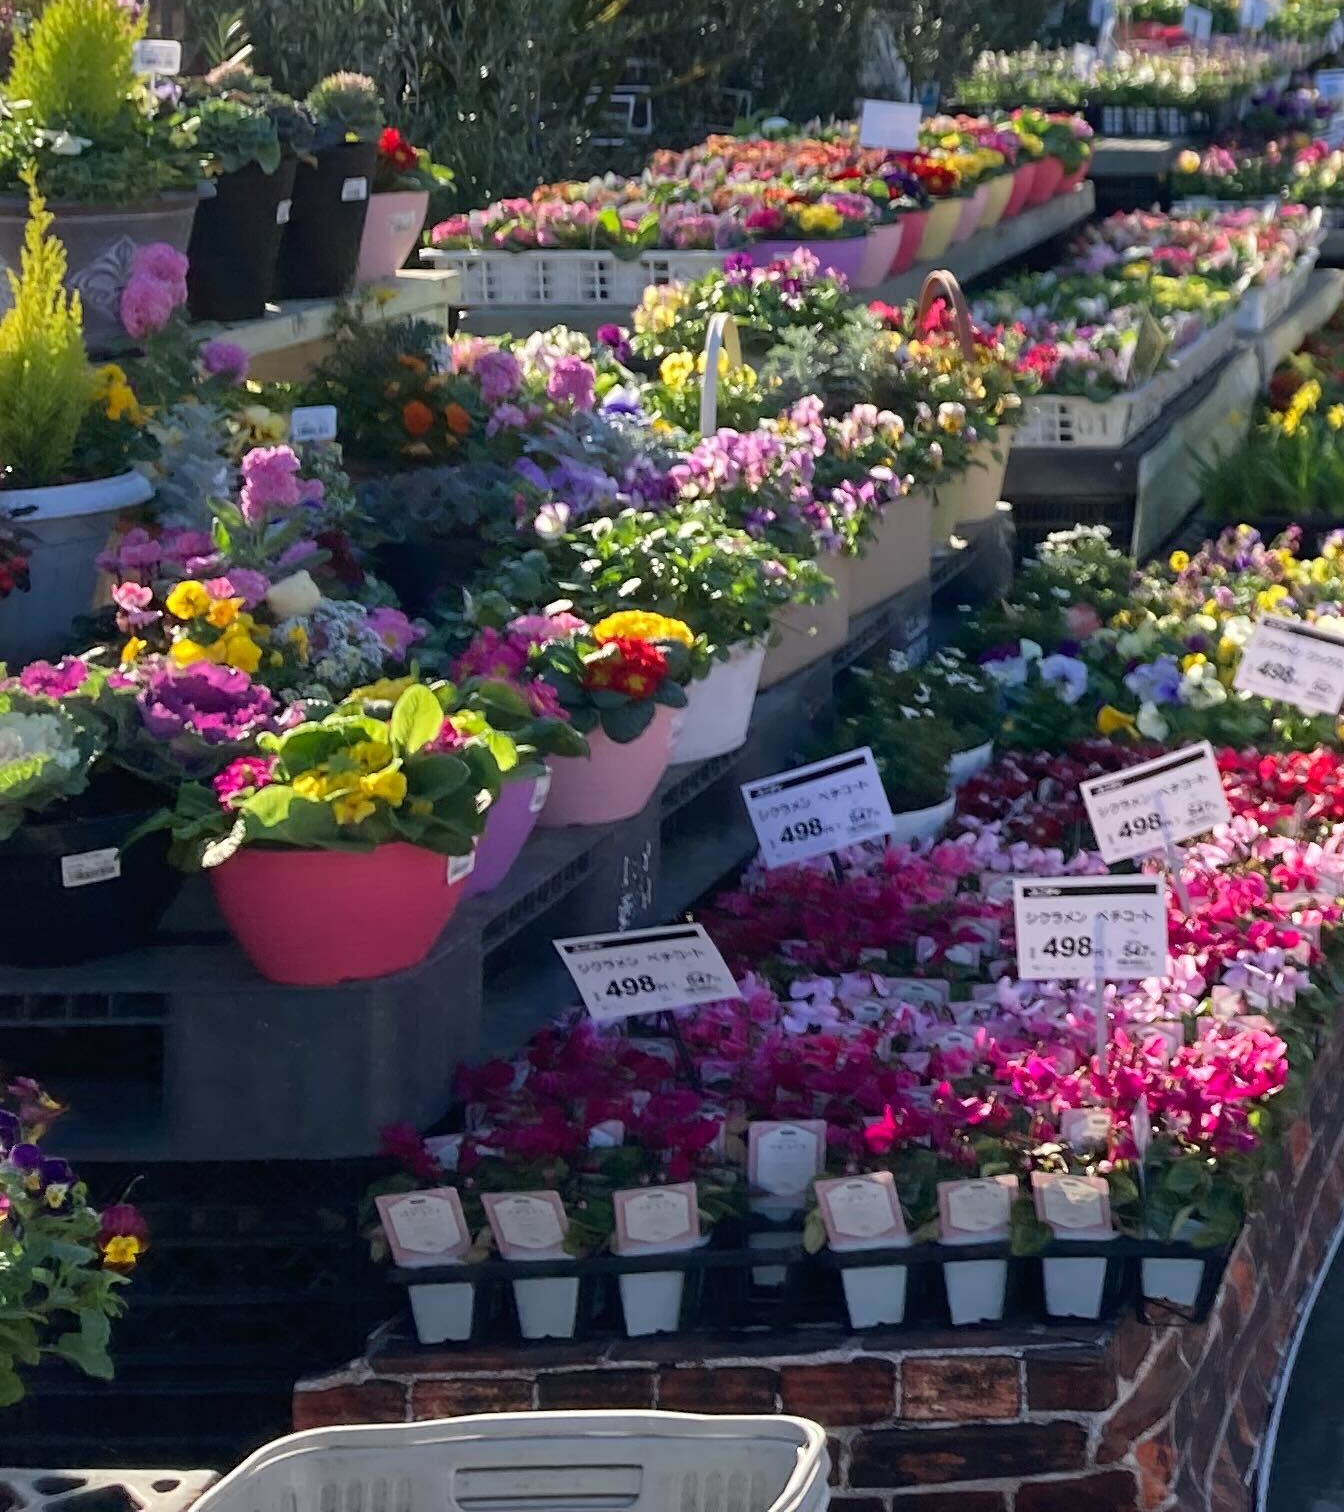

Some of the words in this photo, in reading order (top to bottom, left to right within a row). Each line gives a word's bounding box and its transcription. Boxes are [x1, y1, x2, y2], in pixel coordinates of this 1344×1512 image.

[1258, 662, 1296, 685] 498
[780, 817, 823, 842] 498
[1119, 812, 1161, 839] 498
[1025, 910, 1088, 925] シクラメン
[1043, 936, 1092, 957] 498
[606, 975, 656, 997] 498
